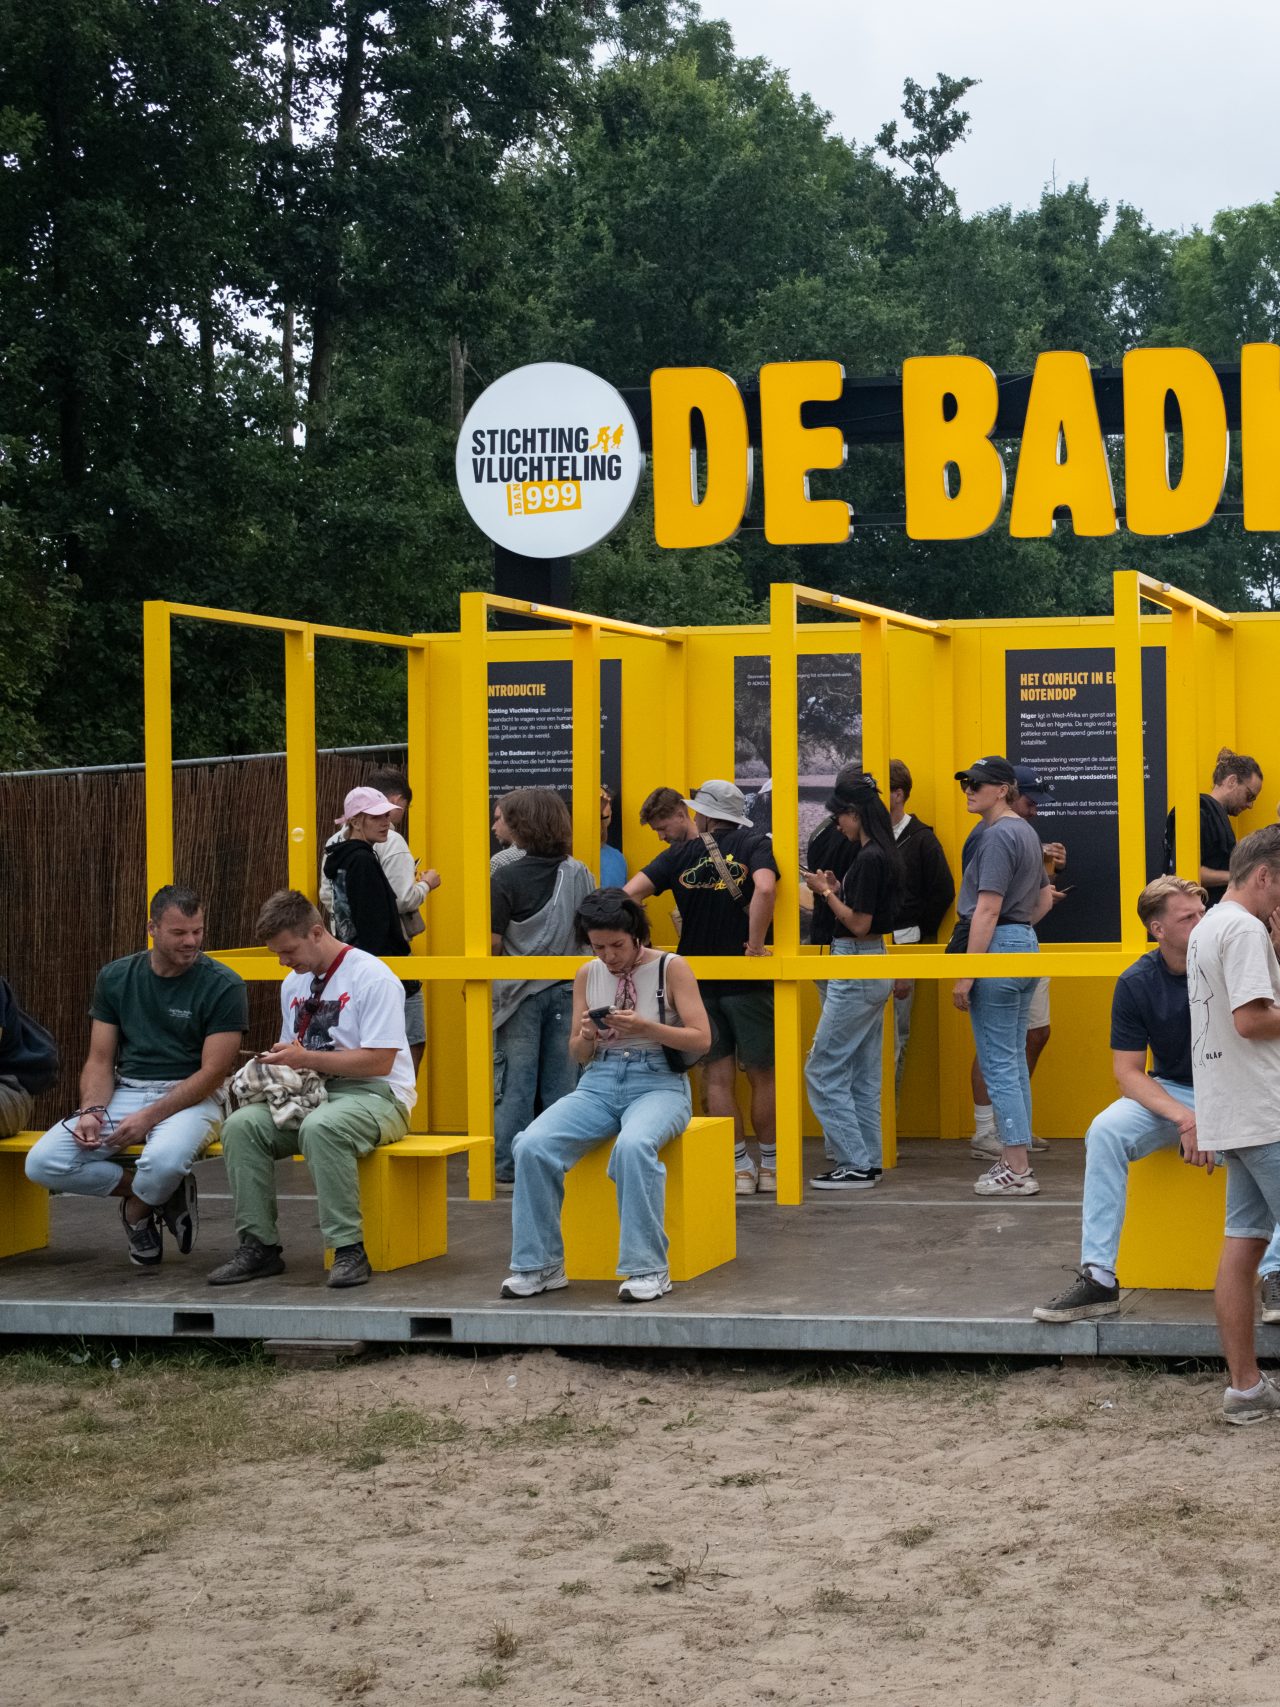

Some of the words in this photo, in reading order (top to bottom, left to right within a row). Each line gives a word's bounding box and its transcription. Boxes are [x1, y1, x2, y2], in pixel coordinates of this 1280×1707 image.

[472, 426, 589, 456] STICHTING
[651, 361, 854, 549] DE
[472, 454, 622, 484] VLUCHTELING
[512, 483, 523, 515] IBAN
[525, 483, 578, 510] 999
[488, 683, 547, 697] NTRODUCTIE
[1020, 673, 1039, 686] HET
[1042, 672, 1089, 685] CONFLICT
[1091, 672, 1103, 684] IN
[1020, 688, 1077, 701] NOTENDOP
